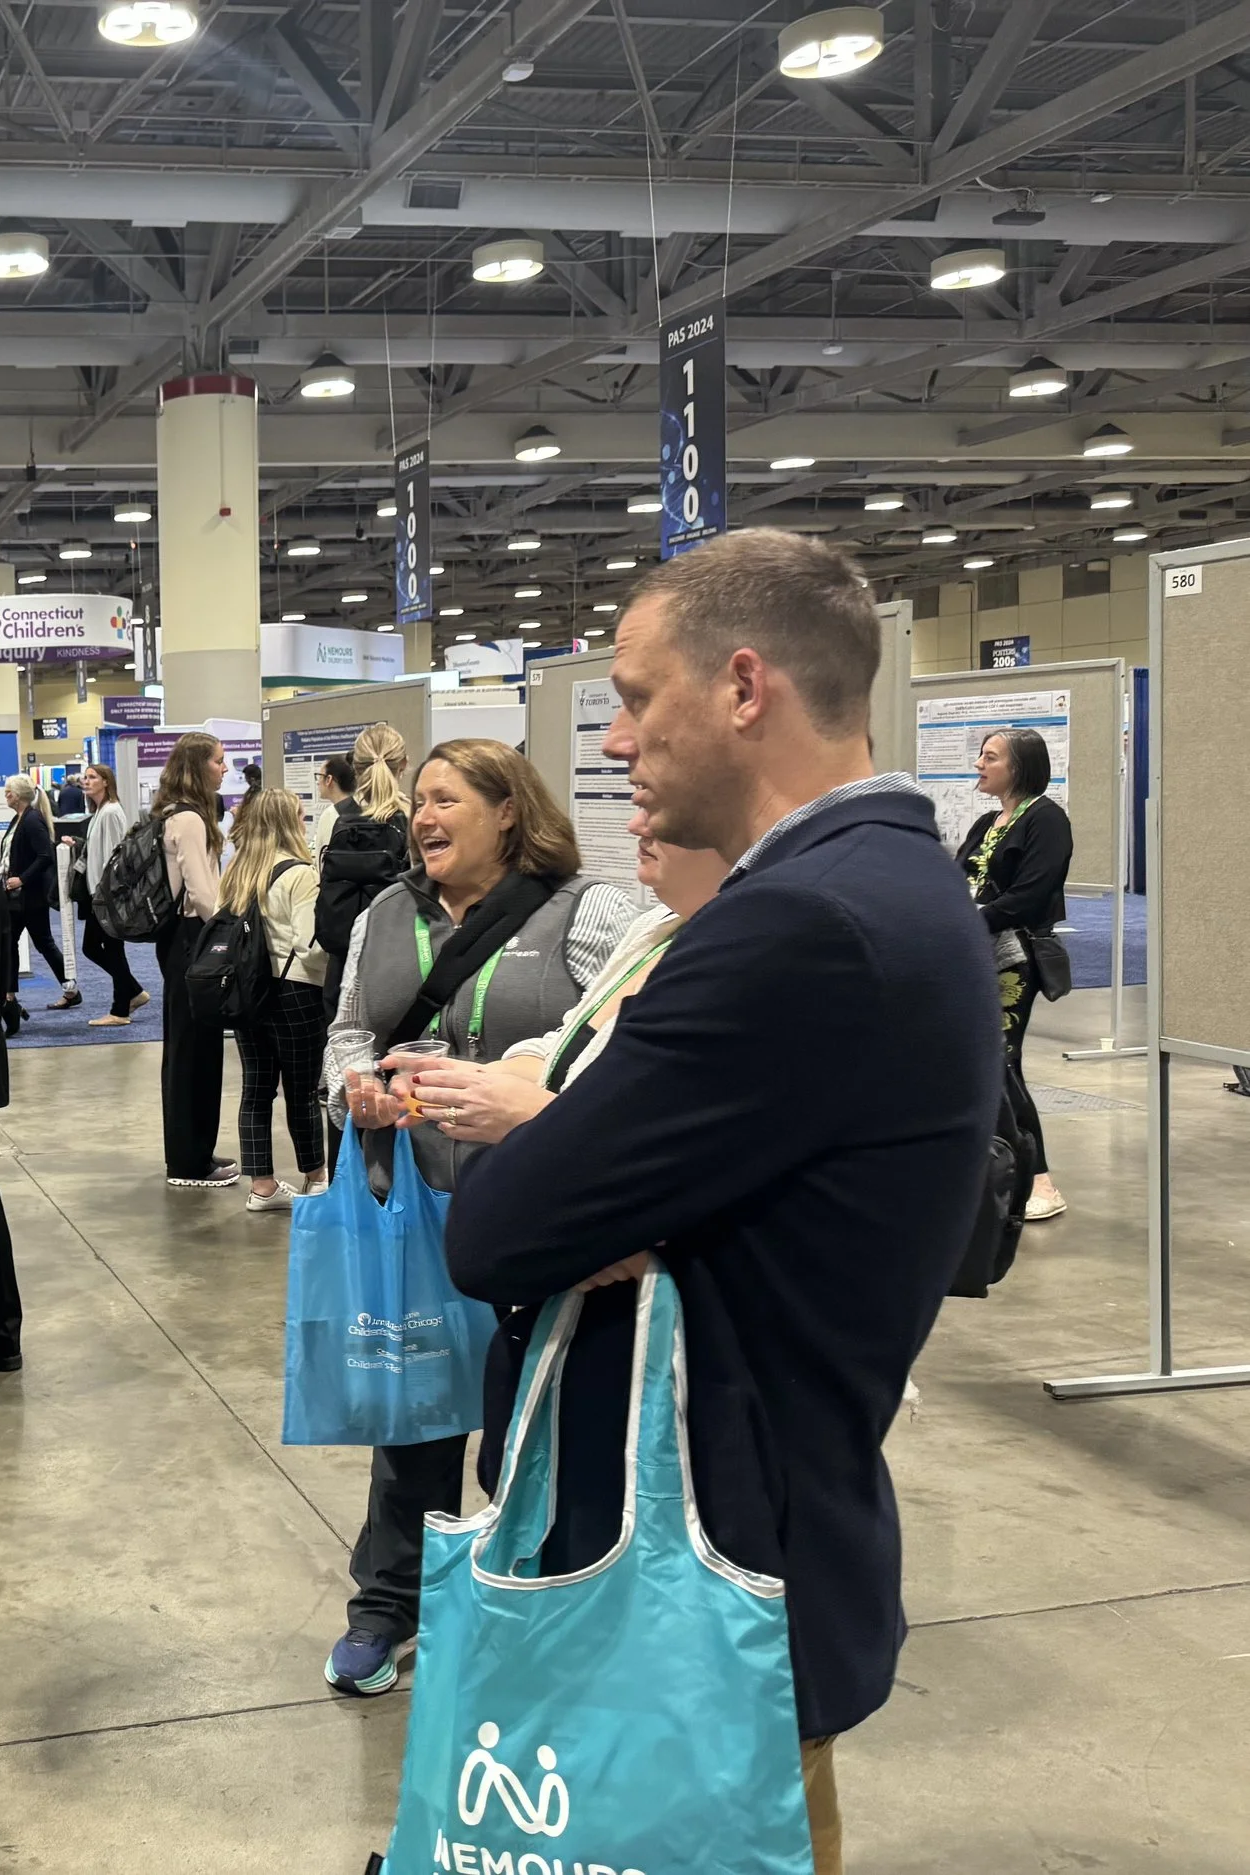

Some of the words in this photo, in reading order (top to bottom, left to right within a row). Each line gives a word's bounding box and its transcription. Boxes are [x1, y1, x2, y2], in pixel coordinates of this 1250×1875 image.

[668, 326, 686, 348] PAS
[687, 314, 715, 340] 2024
[682, 358, 700, 524] 1100
[399, 459, 409, 472] PAS
[410, 451, 424, 468] 2024
[406, 480, 417, 600] 1000
[1172, 573, 1195, 589] 580
[2, 606, 84, 621] Connecticut
[3, 621, 85, 639] Children's
[56, 647, 100, 657] KINDNESS
[993, 656, 1016, 668] 200s
[434, 1828, 647, 1875] NEMO
